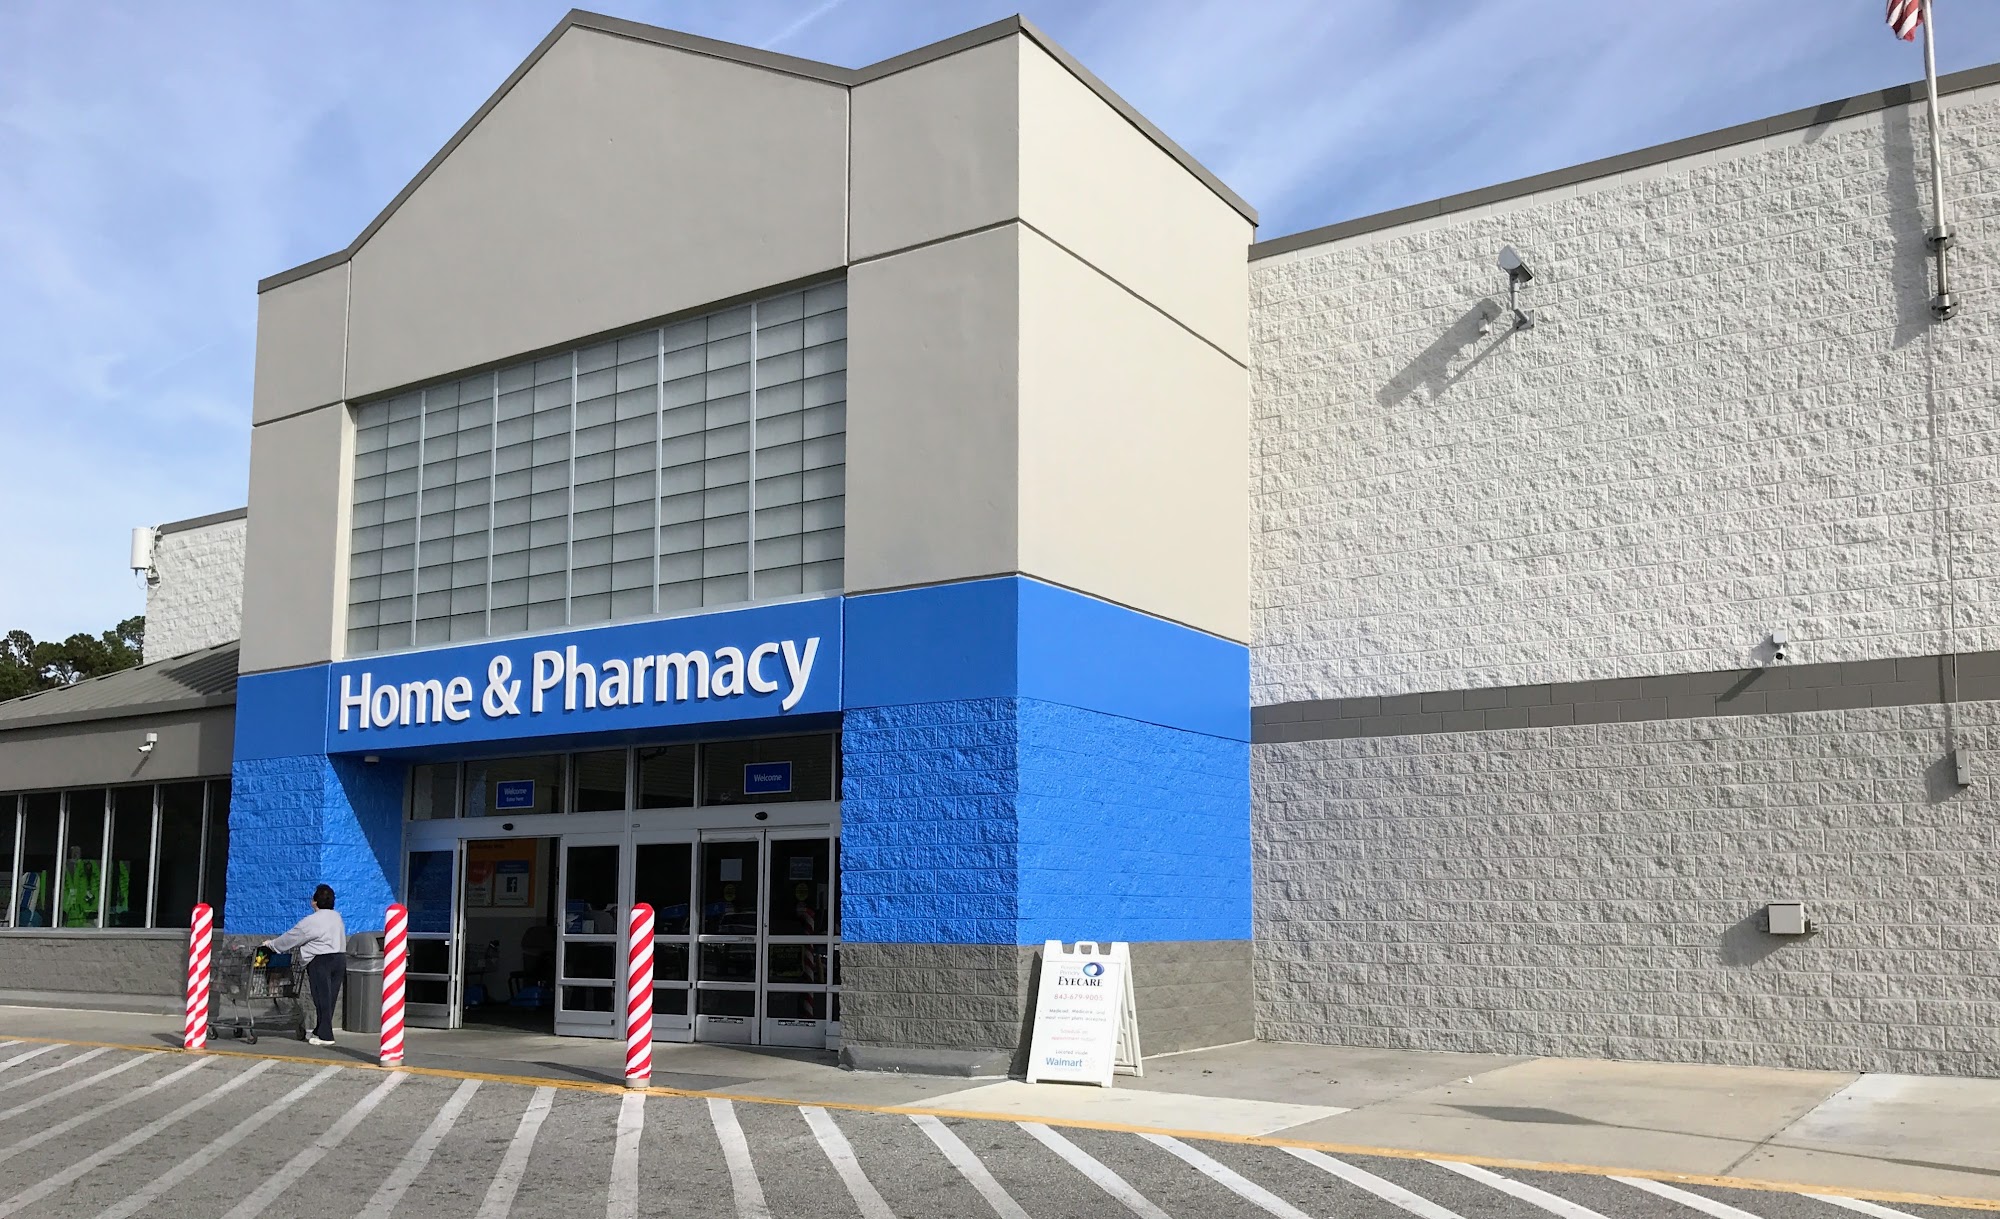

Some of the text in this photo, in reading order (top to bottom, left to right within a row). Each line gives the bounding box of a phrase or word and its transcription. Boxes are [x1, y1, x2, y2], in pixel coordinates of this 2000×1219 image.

[339, 636, 820, 731] Home & Pharmacy
[753, 773, 783, 783] Welcome
[1058, 976, 1103, 987] EYECARE
[1045, 1057, 1083, 1067] Walmart
